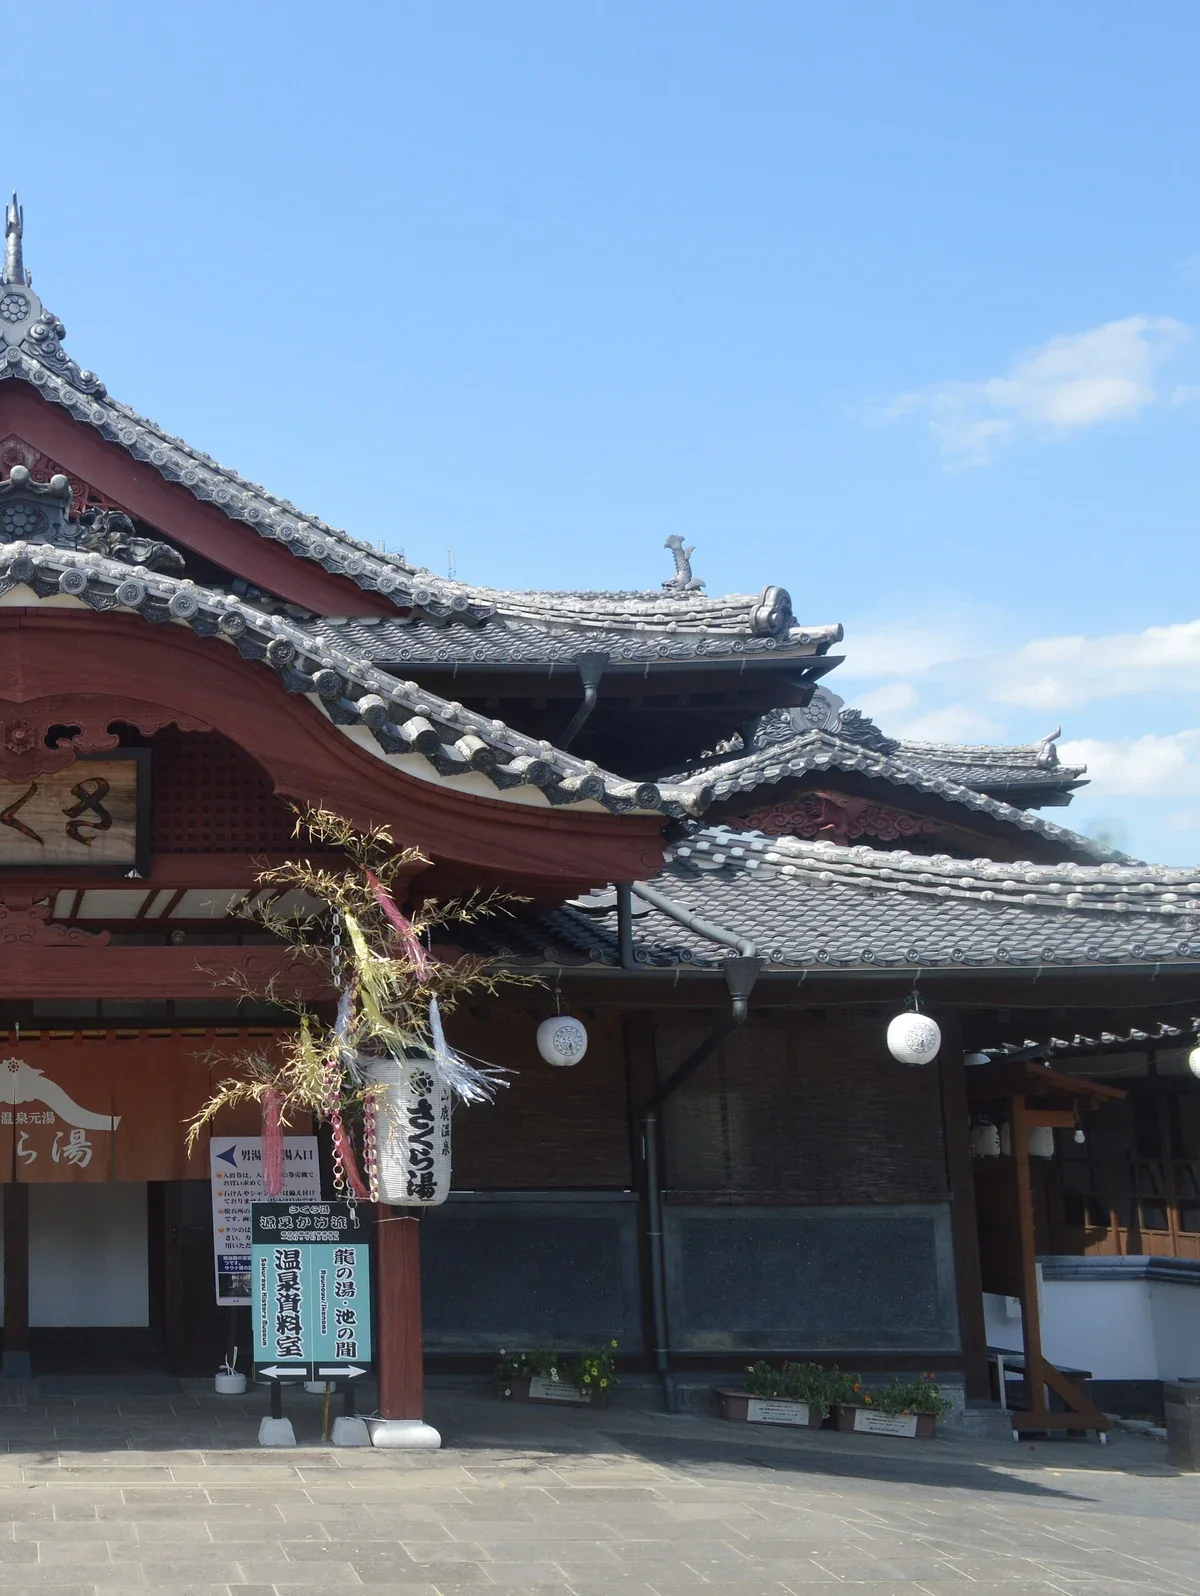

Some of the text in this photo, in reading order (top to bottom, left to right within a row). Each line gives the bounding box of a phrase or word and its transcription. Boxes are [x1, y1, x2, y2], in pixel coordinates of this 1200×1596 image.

[407, 1098, 437, 1199] さくら湯
[274, 1248, 303, 1358] 温泉資料室
[334, 1248, 358, 1359] 龍の湯・池の間
